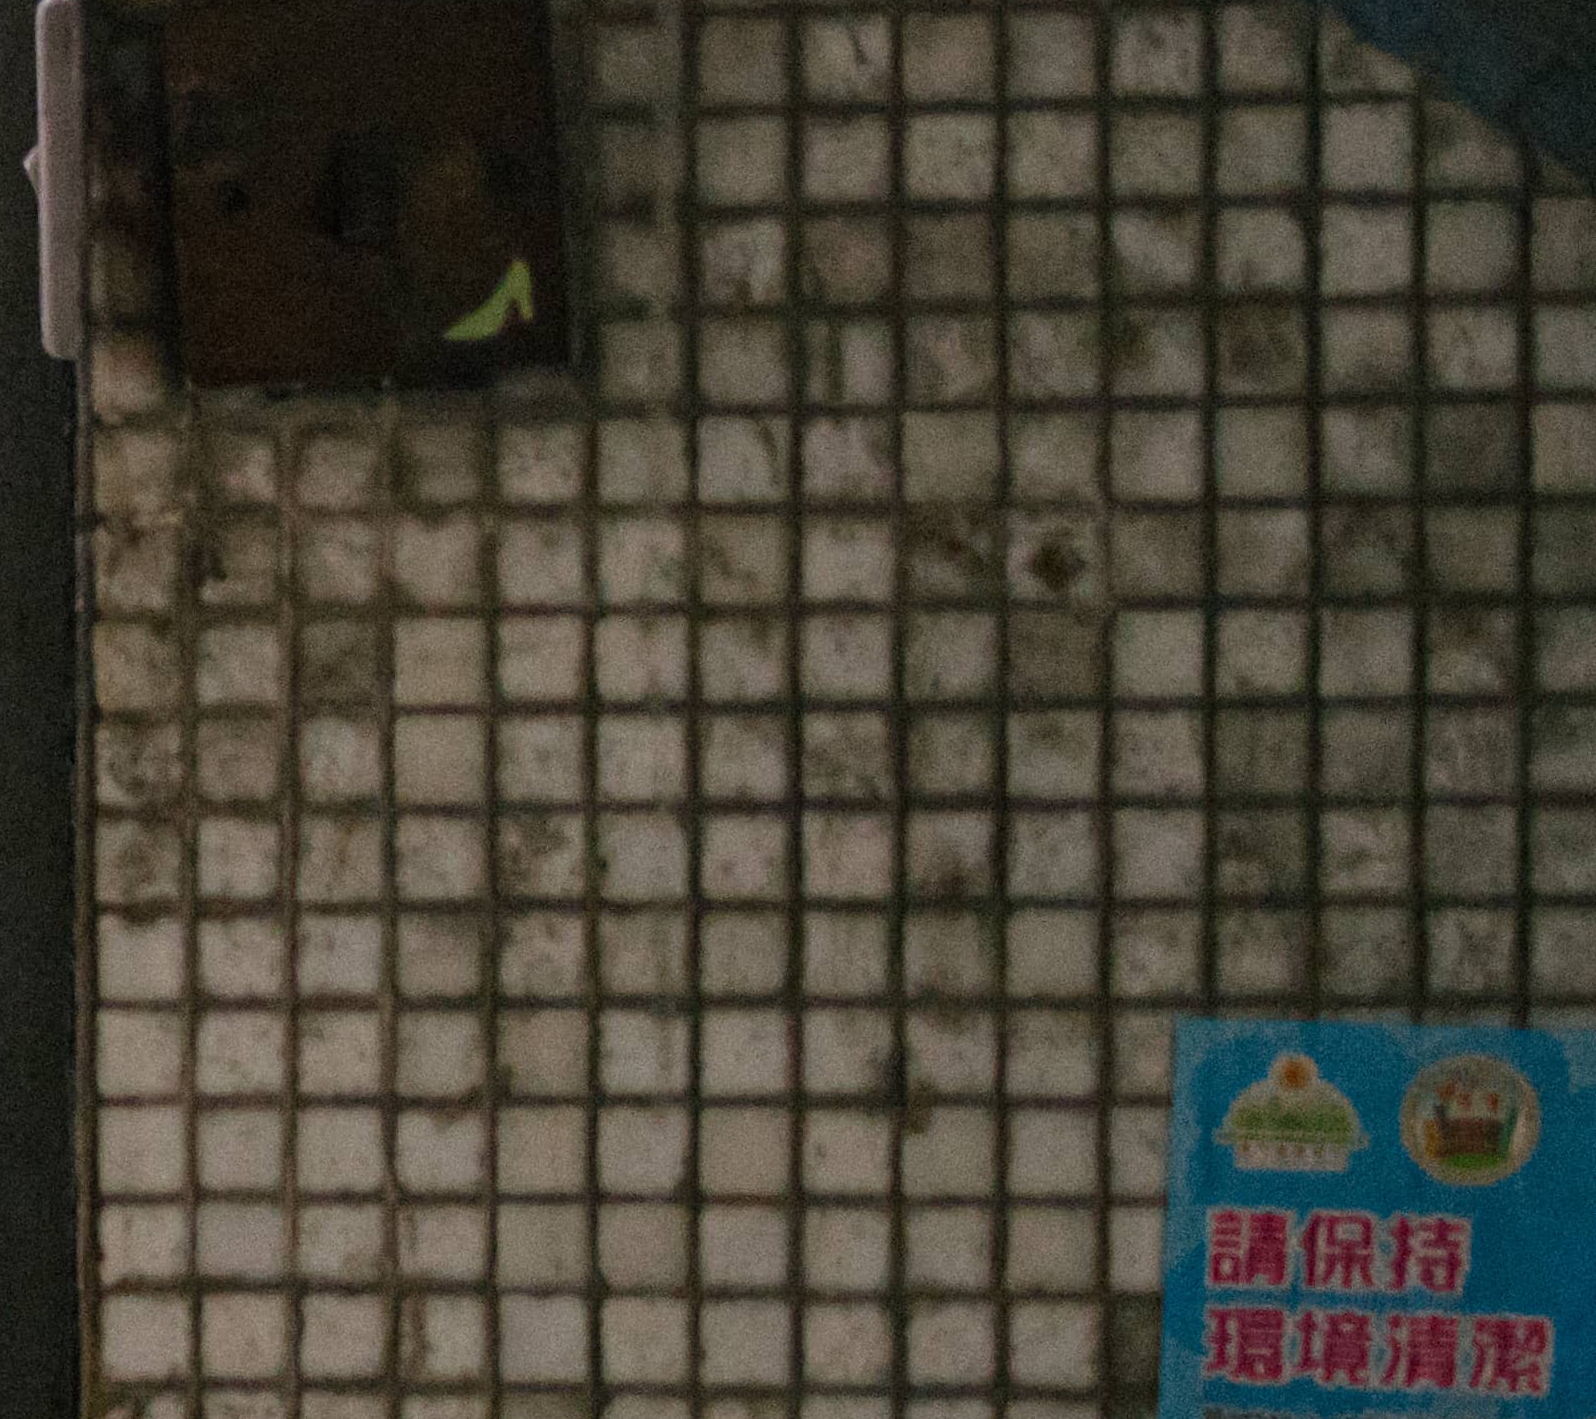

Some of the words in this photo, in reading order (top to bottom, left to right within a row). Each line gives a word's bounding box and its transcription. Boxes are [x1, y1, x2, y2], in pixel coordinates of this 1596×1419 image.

[1206, 1207, 1473, 1297] 請保持
[1202, 1304, 1555, 1399] 環境清潔
